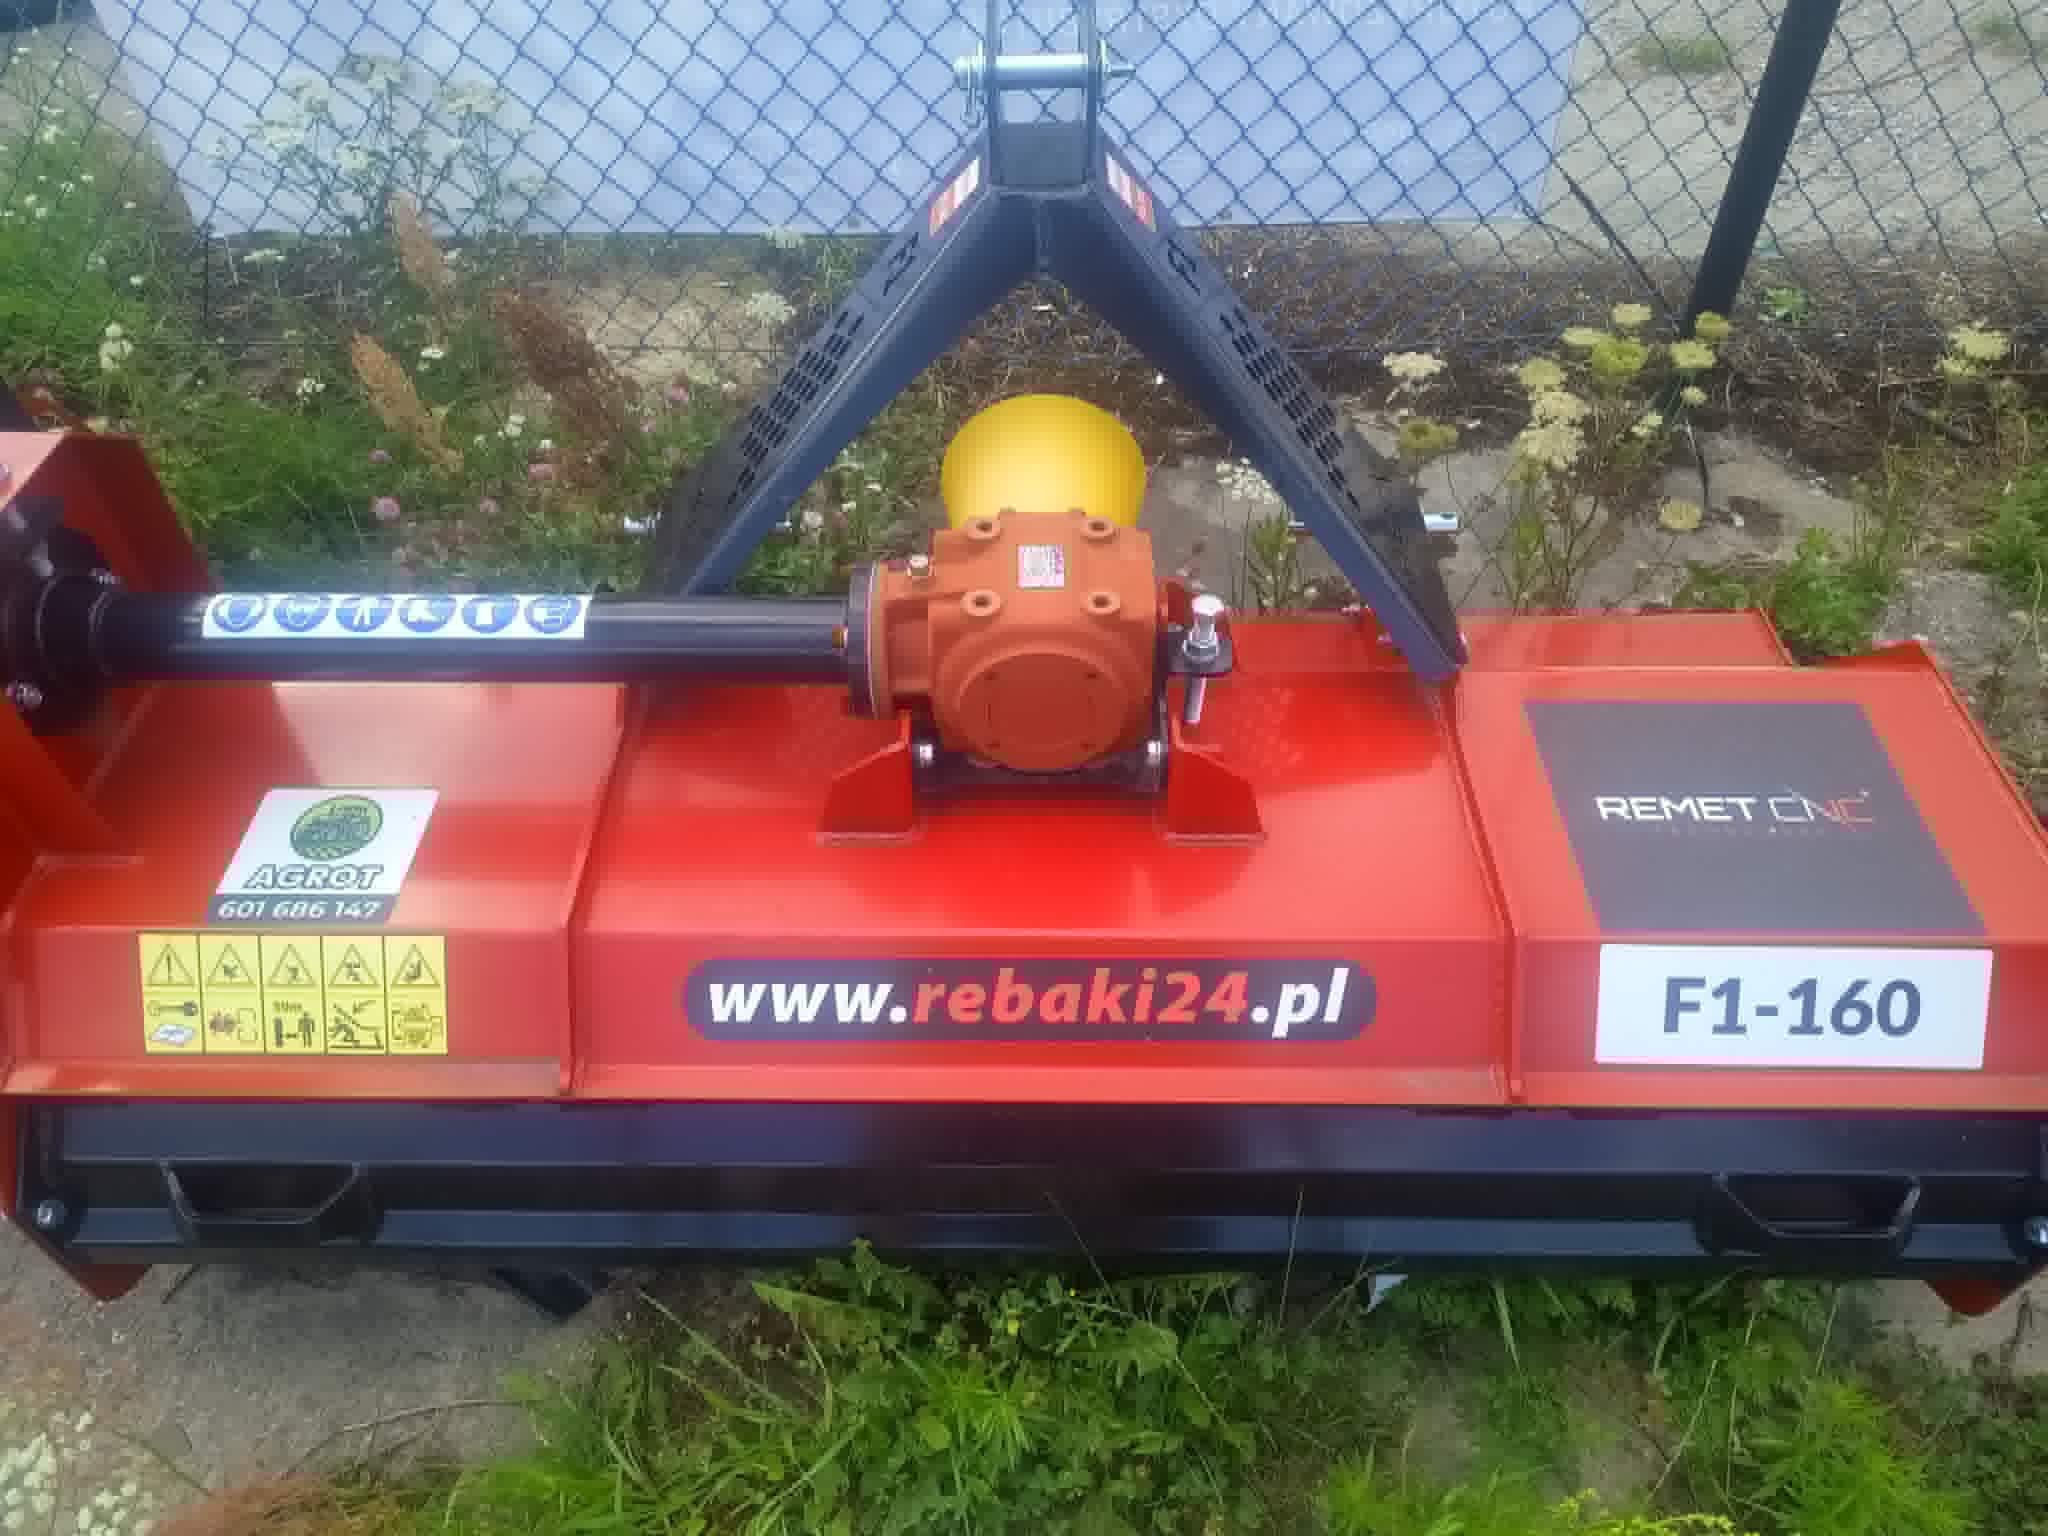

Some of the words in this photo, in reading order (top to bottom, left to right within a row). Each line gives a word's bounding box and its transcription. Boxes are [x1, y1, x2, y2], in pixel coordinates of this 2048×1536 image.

[1594, 794, 1757, 821] REMET
[217, 900, 265, 920] 601
[335, 901, 383, 919] 147
[707, 966, 1350, 1039] www.rebaki24.pl
[1662, 976, 1922, 1037] F1-160
